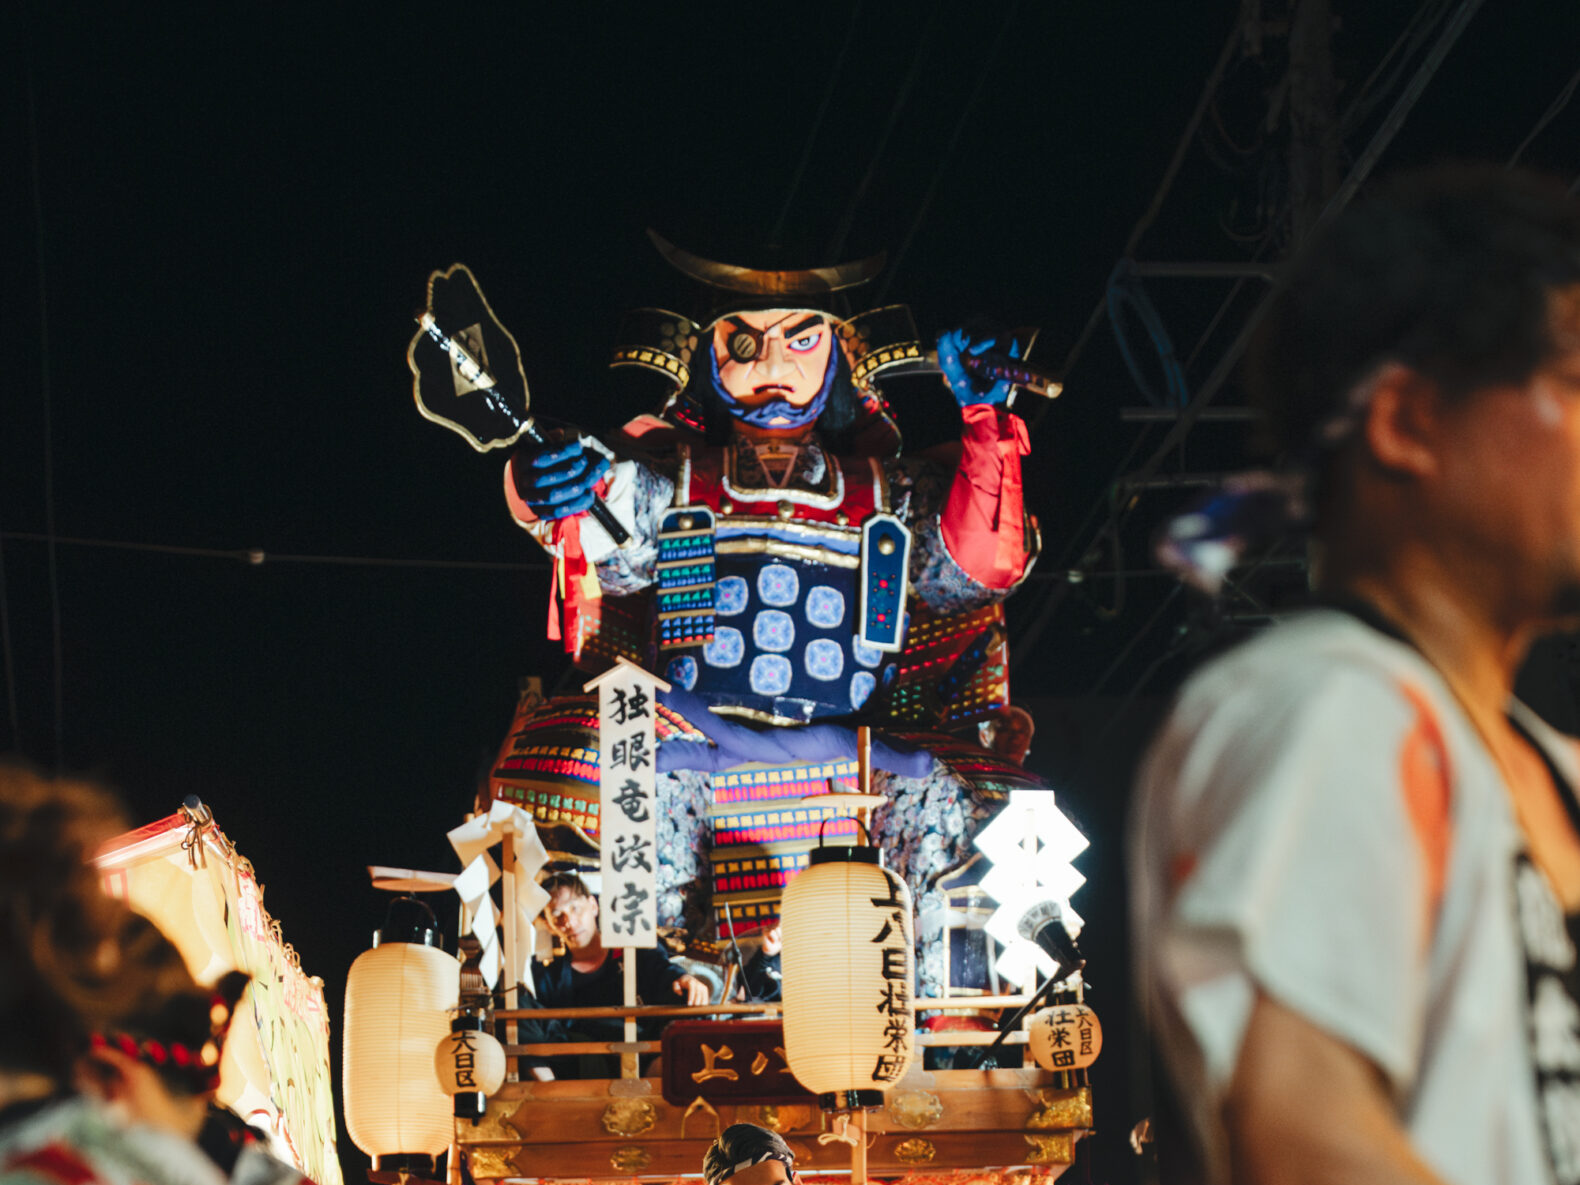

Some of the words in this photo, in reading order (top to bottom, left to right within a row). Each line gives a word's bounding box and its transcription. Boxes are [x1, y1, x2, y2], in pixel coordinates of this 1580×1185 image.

[608, 684, 652, 935] 独眼竜政宗
